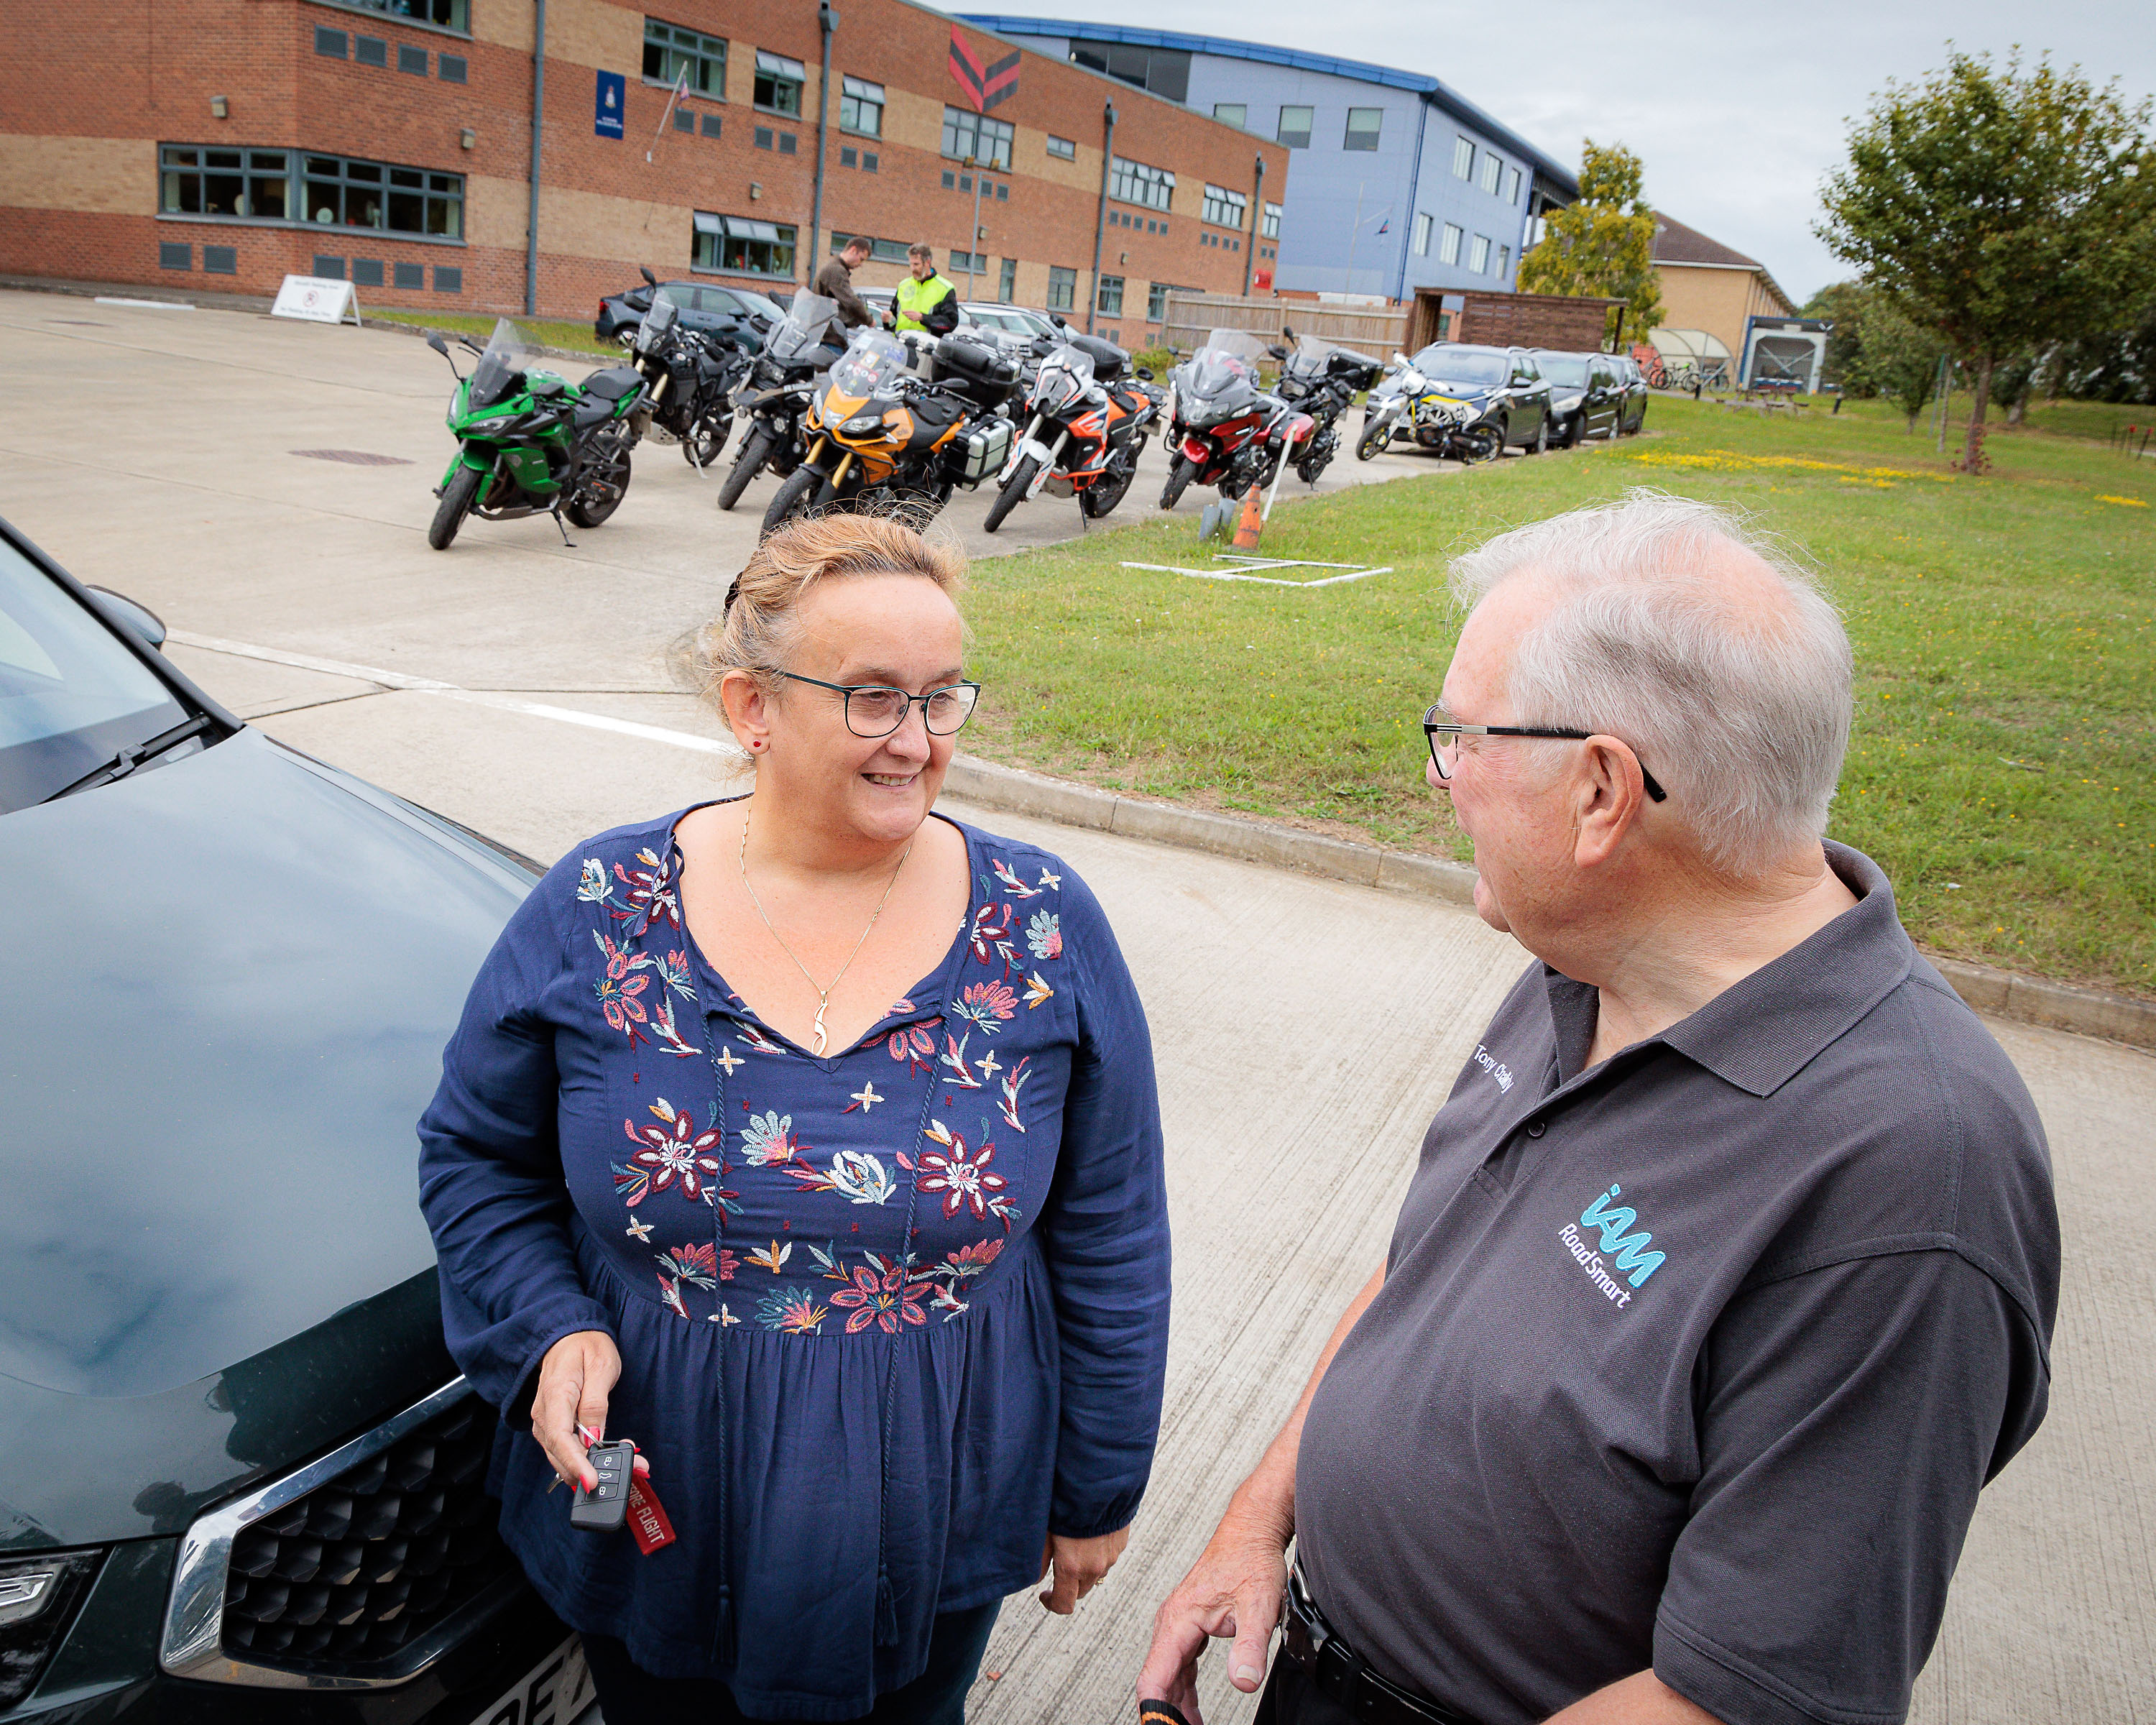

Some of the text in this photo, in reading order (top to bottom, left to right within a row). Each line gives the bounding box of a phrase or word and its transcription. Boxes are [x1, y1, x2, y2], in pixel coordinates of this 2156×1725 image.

[1474, 1044, 1498, 1073] Tony
[1558, 1223, 1631, 1309] RoadSmart
[636, 1506, 665, 1543] FLIGHT
